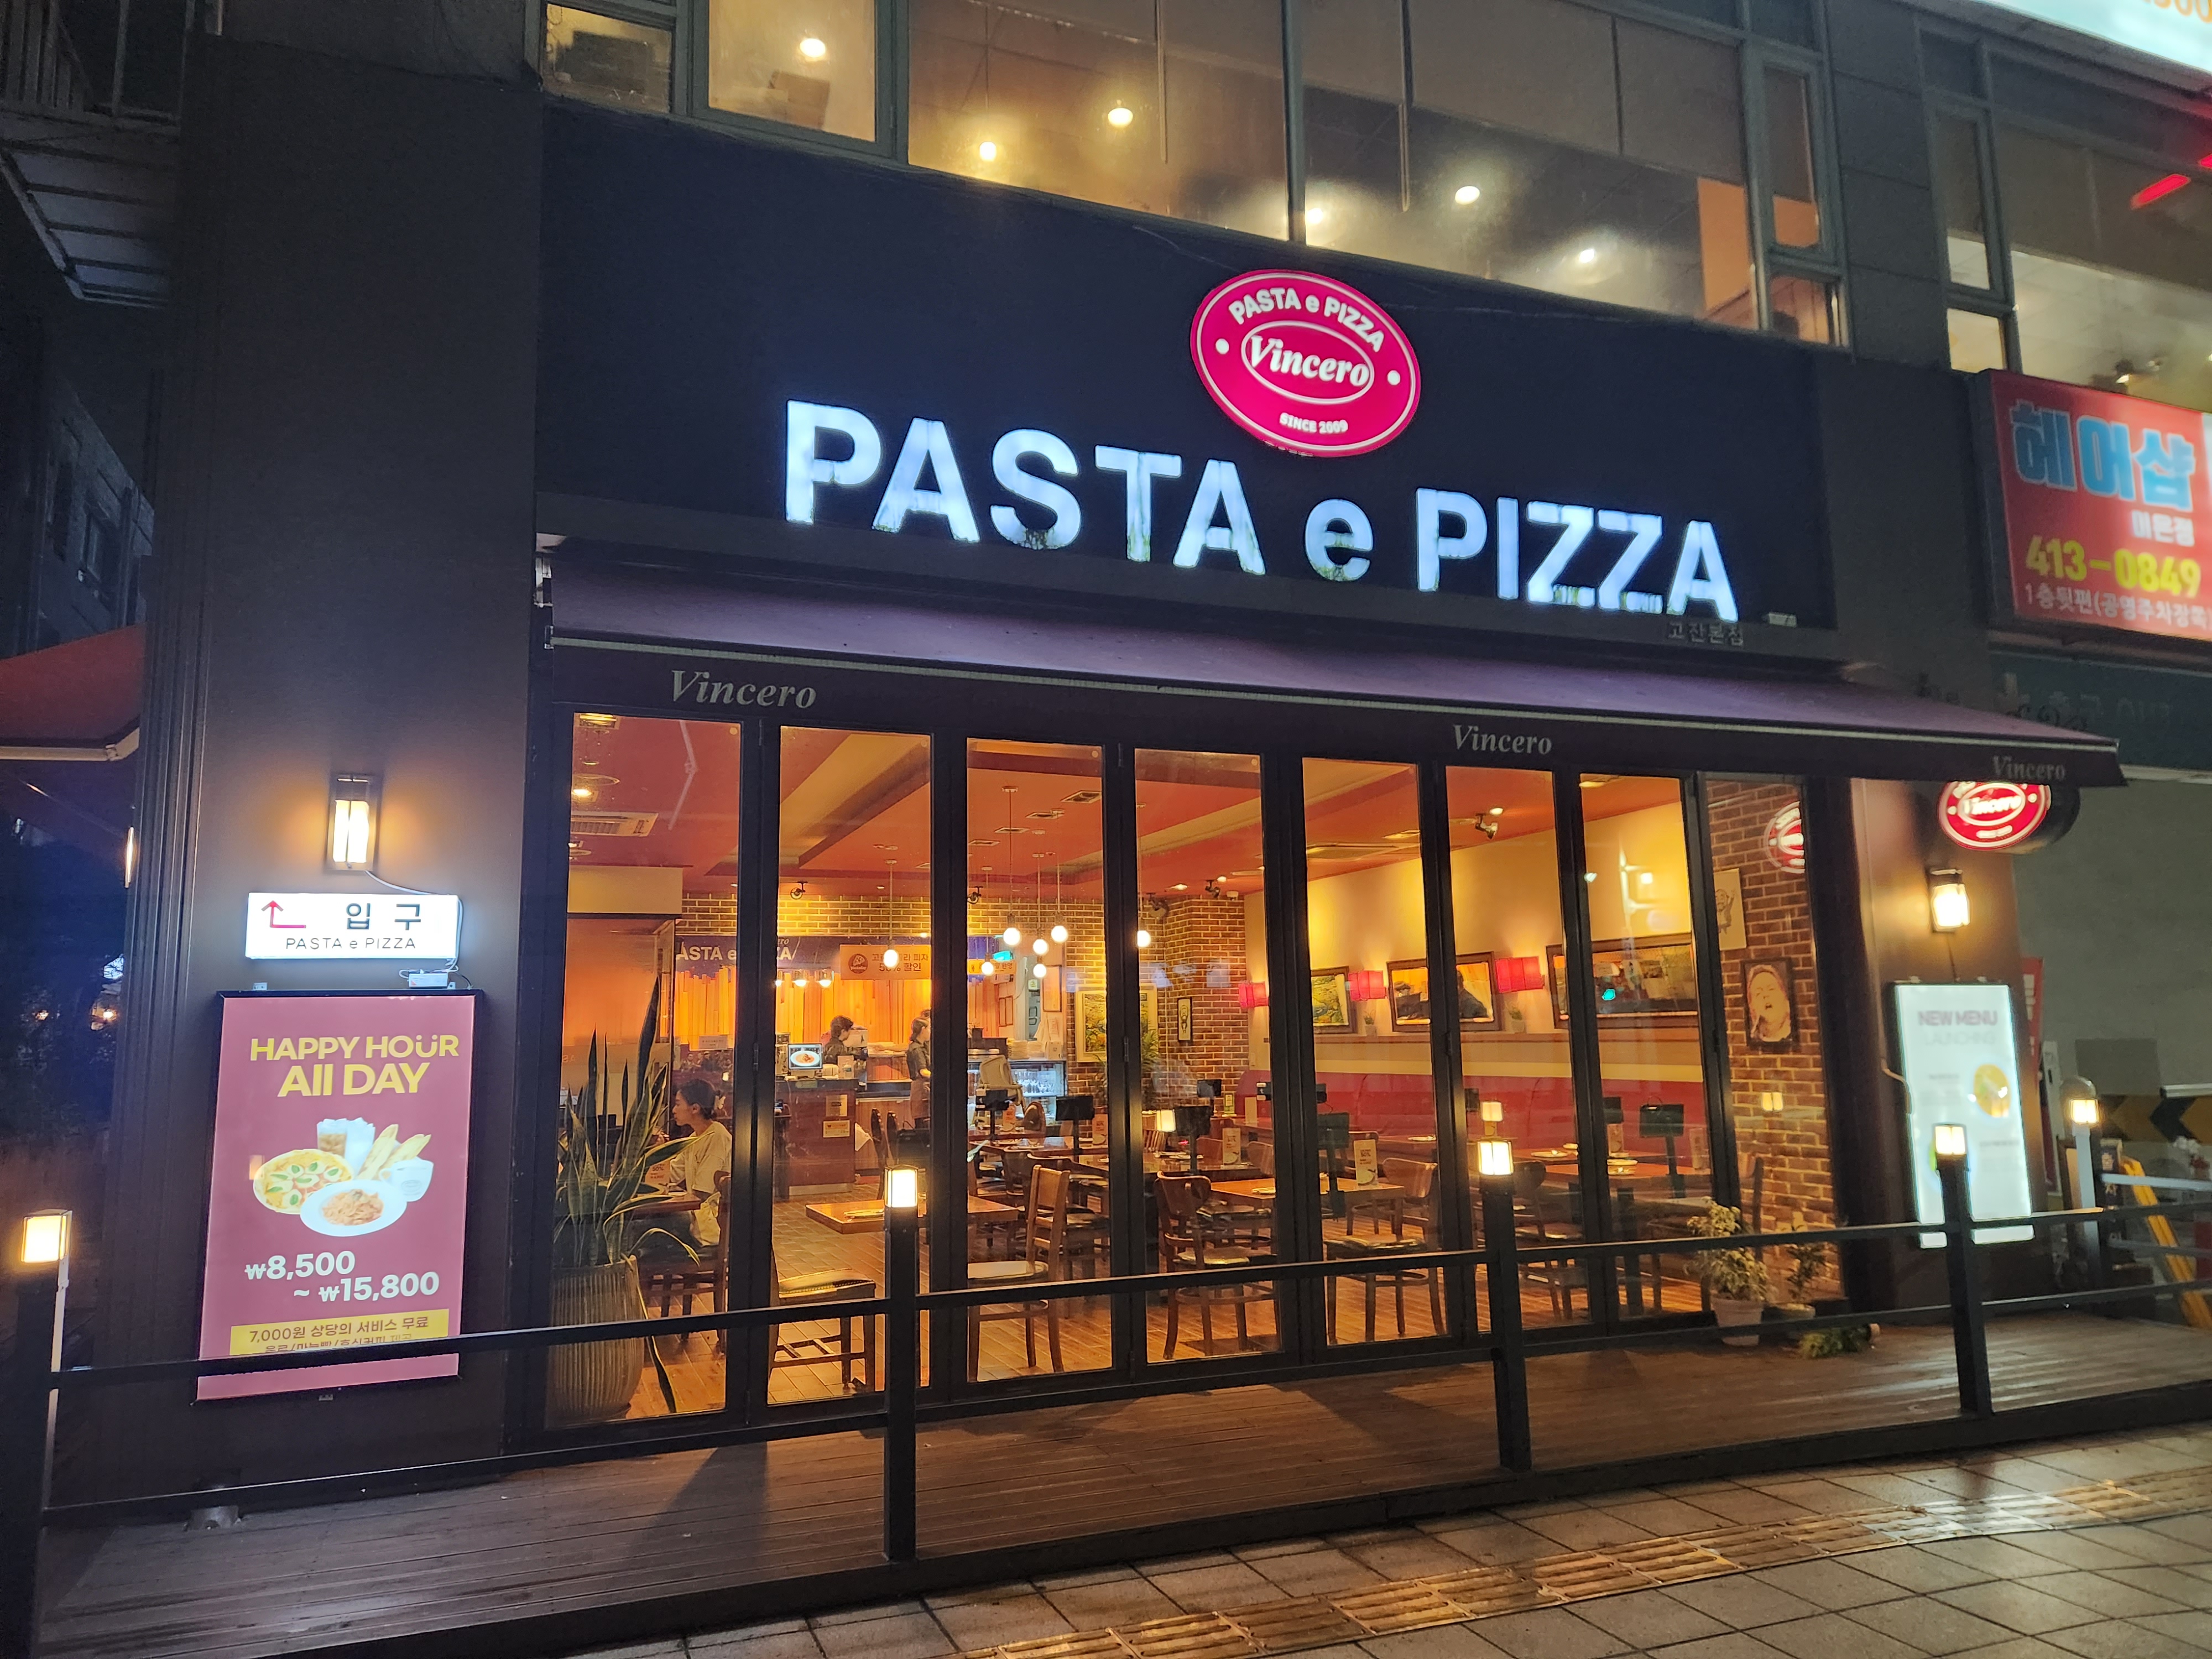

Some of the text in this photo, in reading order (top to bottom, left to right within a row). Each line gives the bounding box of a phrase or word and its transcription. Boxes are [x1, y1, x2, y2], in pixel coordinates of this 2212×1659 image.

[1229, 288, 1384, 352] PASTA e PIZZA
[1250, 335, 1369, 387] Vincero
[1280, 413, 1317, 432] SINCE
[2010, 399, 2195, 512] 헤어샵
[785, 399, 1739, 623] PASTA e PIZZA
[2026, 535, 2201, 598] 413-0849
[671, 670, 816, 708] Vincero
[1453, 724, 1552, 754] Vincero
[1992, 755, 2066, 781] Vincero
[286, 938, 416, 950] PASTA e PIZZA
[676, 946, 723, 960] ASTA
[904, 962, 921, 972] 할인
[1918, 1009, 1998, 1026] NEW MENU
[250, 1037, 360, 1061] HAPPY
[343, 1062, 430, 1095] DAY
[249, 1317, 429, 1344] 7,000원 상당의 서비스 무료
